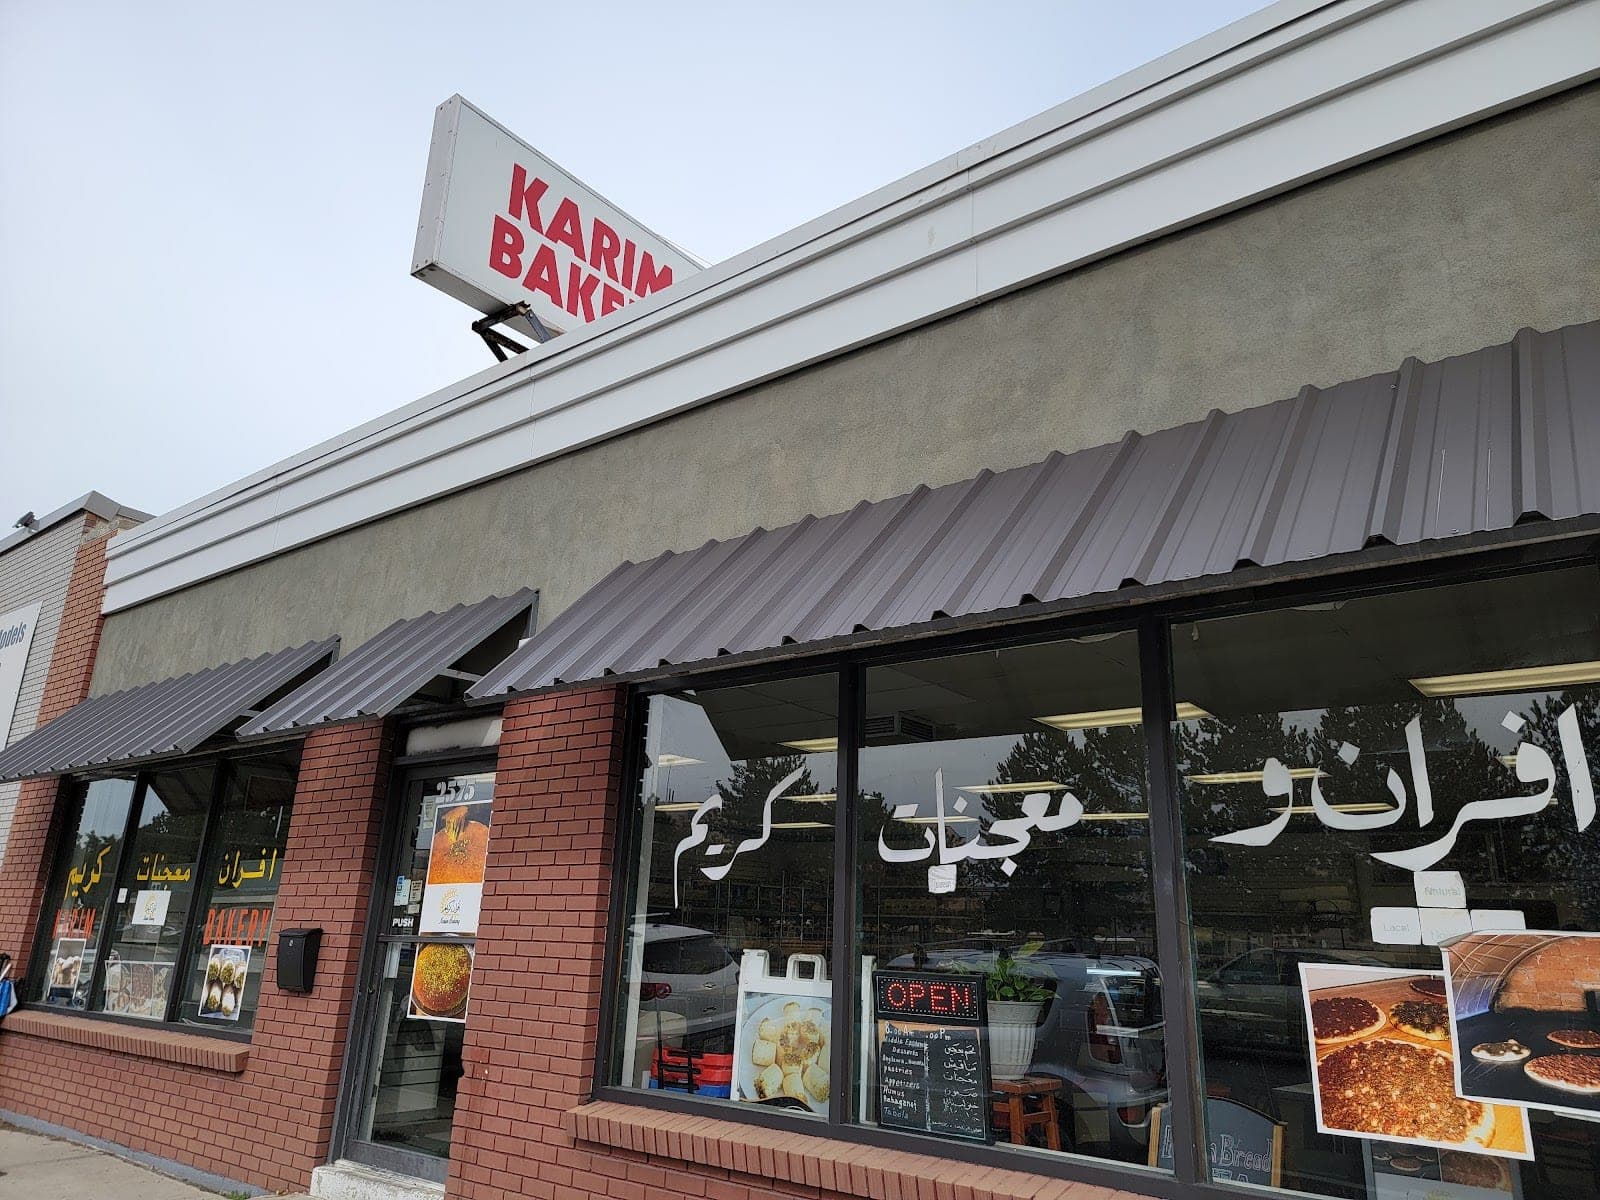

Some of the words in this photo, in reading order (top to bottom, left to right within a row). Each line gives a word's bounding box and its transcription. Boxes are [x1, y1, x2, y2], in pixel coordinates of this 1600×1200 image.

[508, 163, 673, 297] KARIM
[0, 621, 27, 650] odels
[436, 780, 476, 802] 2575
[1311, 703, 1597, 872] افران
[674, 765, 806, 909] كريم
[878, 767, 1084, 877] معجنات
[64, 845, 113, 901] كريم
[136, 852, 192, 891] معجنات
[218, 847, 279, 889] افران
[203, 908, 271, 947] BAKERY
[392, 917, 414, 928] PUSH
[887, 982, 970, 1013] OPEN
[1219, 1133, 1273, 1173] Bread
